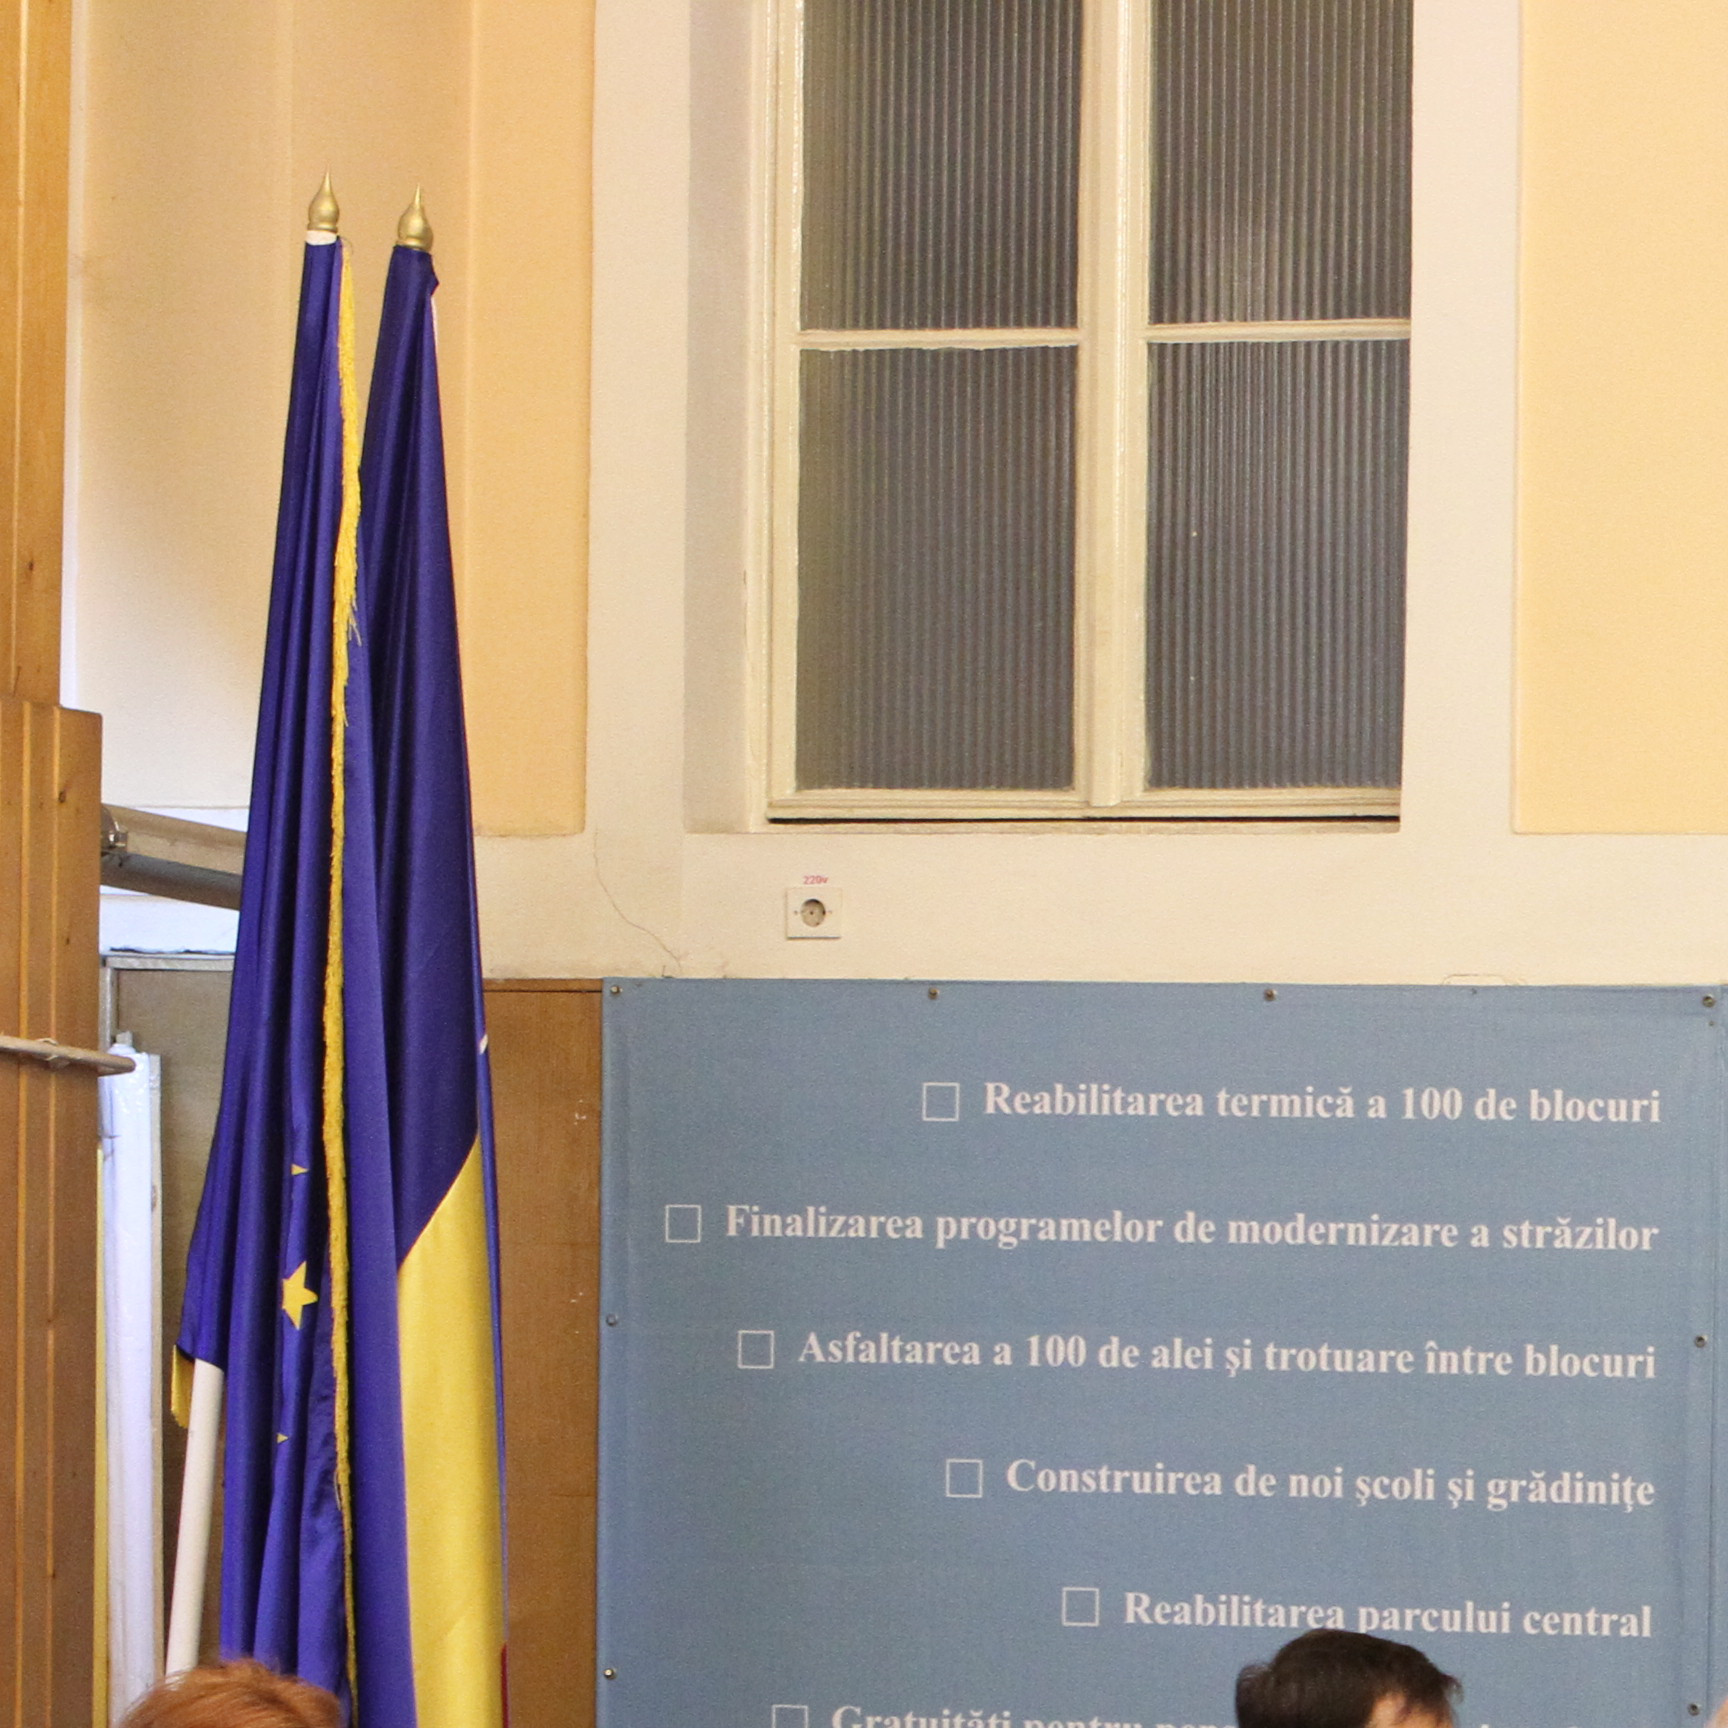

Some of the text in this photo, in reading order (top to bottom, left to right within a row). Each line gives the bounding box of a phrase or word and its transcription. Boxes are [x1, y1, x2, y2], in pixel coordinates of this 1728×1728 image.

[986, 1082, 1660, 1123] Reabilitarea termică a 100 de blocuri
[728, 1204, 1660, 1251] Finalizarea programelor de modernizare a străzilor
[800, 1331, 1655, 1380] Asfaltarea a 100 de alei şi trotuare între blocuri
[1006, 1459, 1655, 1513] Construirea de noi şcoli şi grădiniţe
[1125, 1591, 1651, 1638] Reabilitarea parcului central
